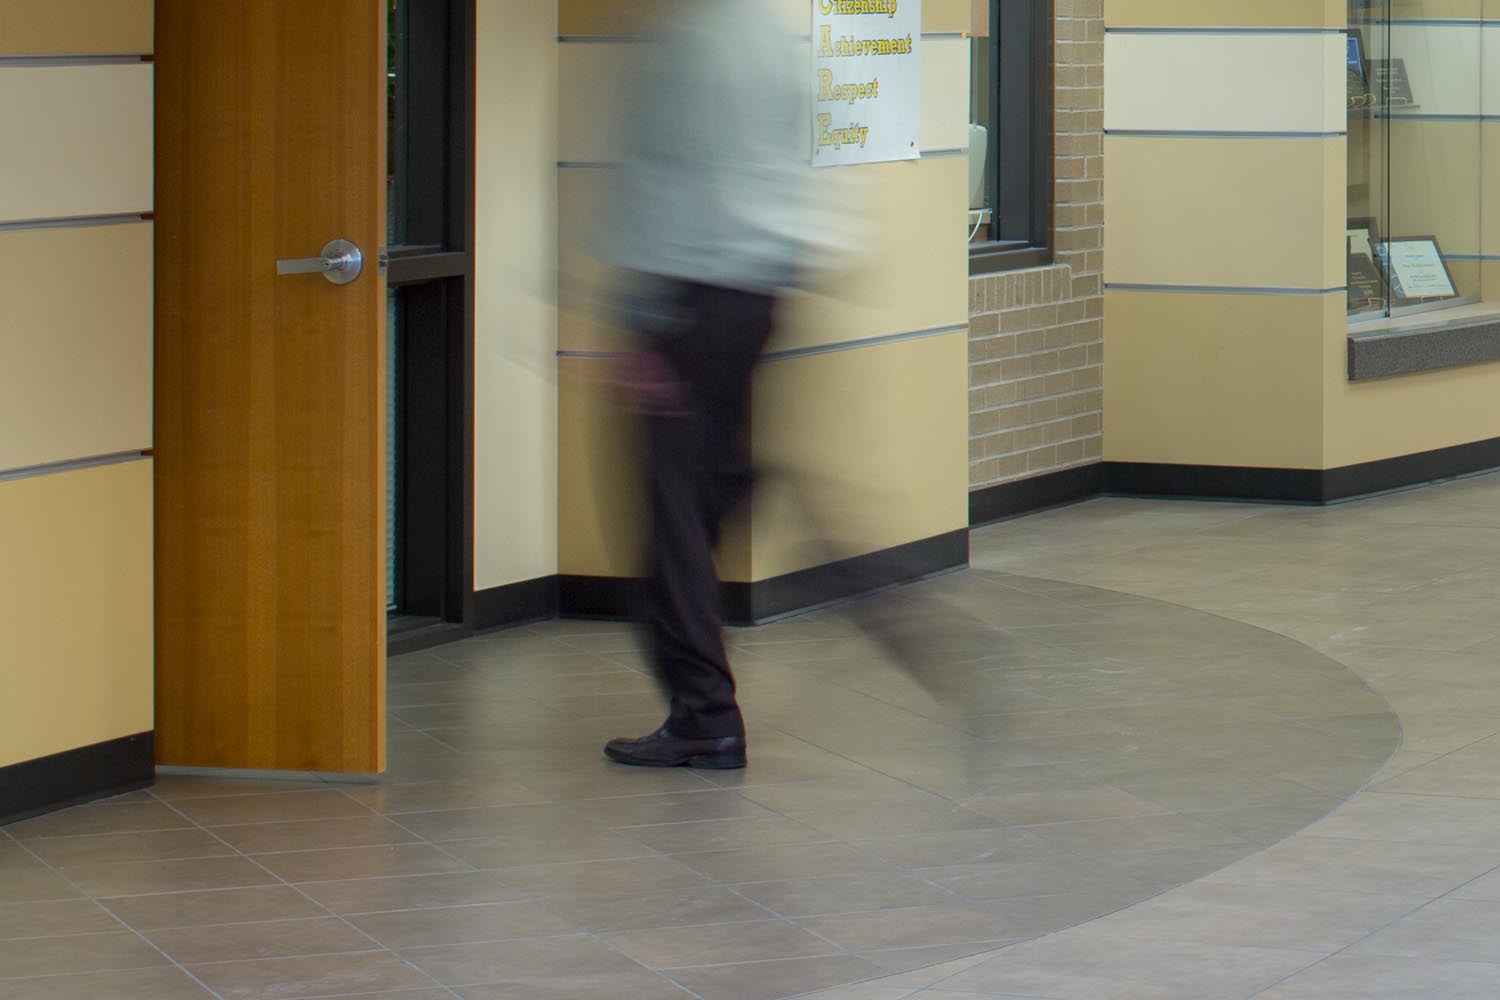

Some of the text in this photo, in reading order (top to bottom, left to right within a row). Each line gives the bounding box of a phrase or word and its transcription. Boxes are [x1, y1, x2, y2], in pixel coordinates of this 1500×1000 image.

[817, 25, 912, 58] Achievement
[816, 68, 879, 105] Respect
[816, 112, 869, 150] Equity
